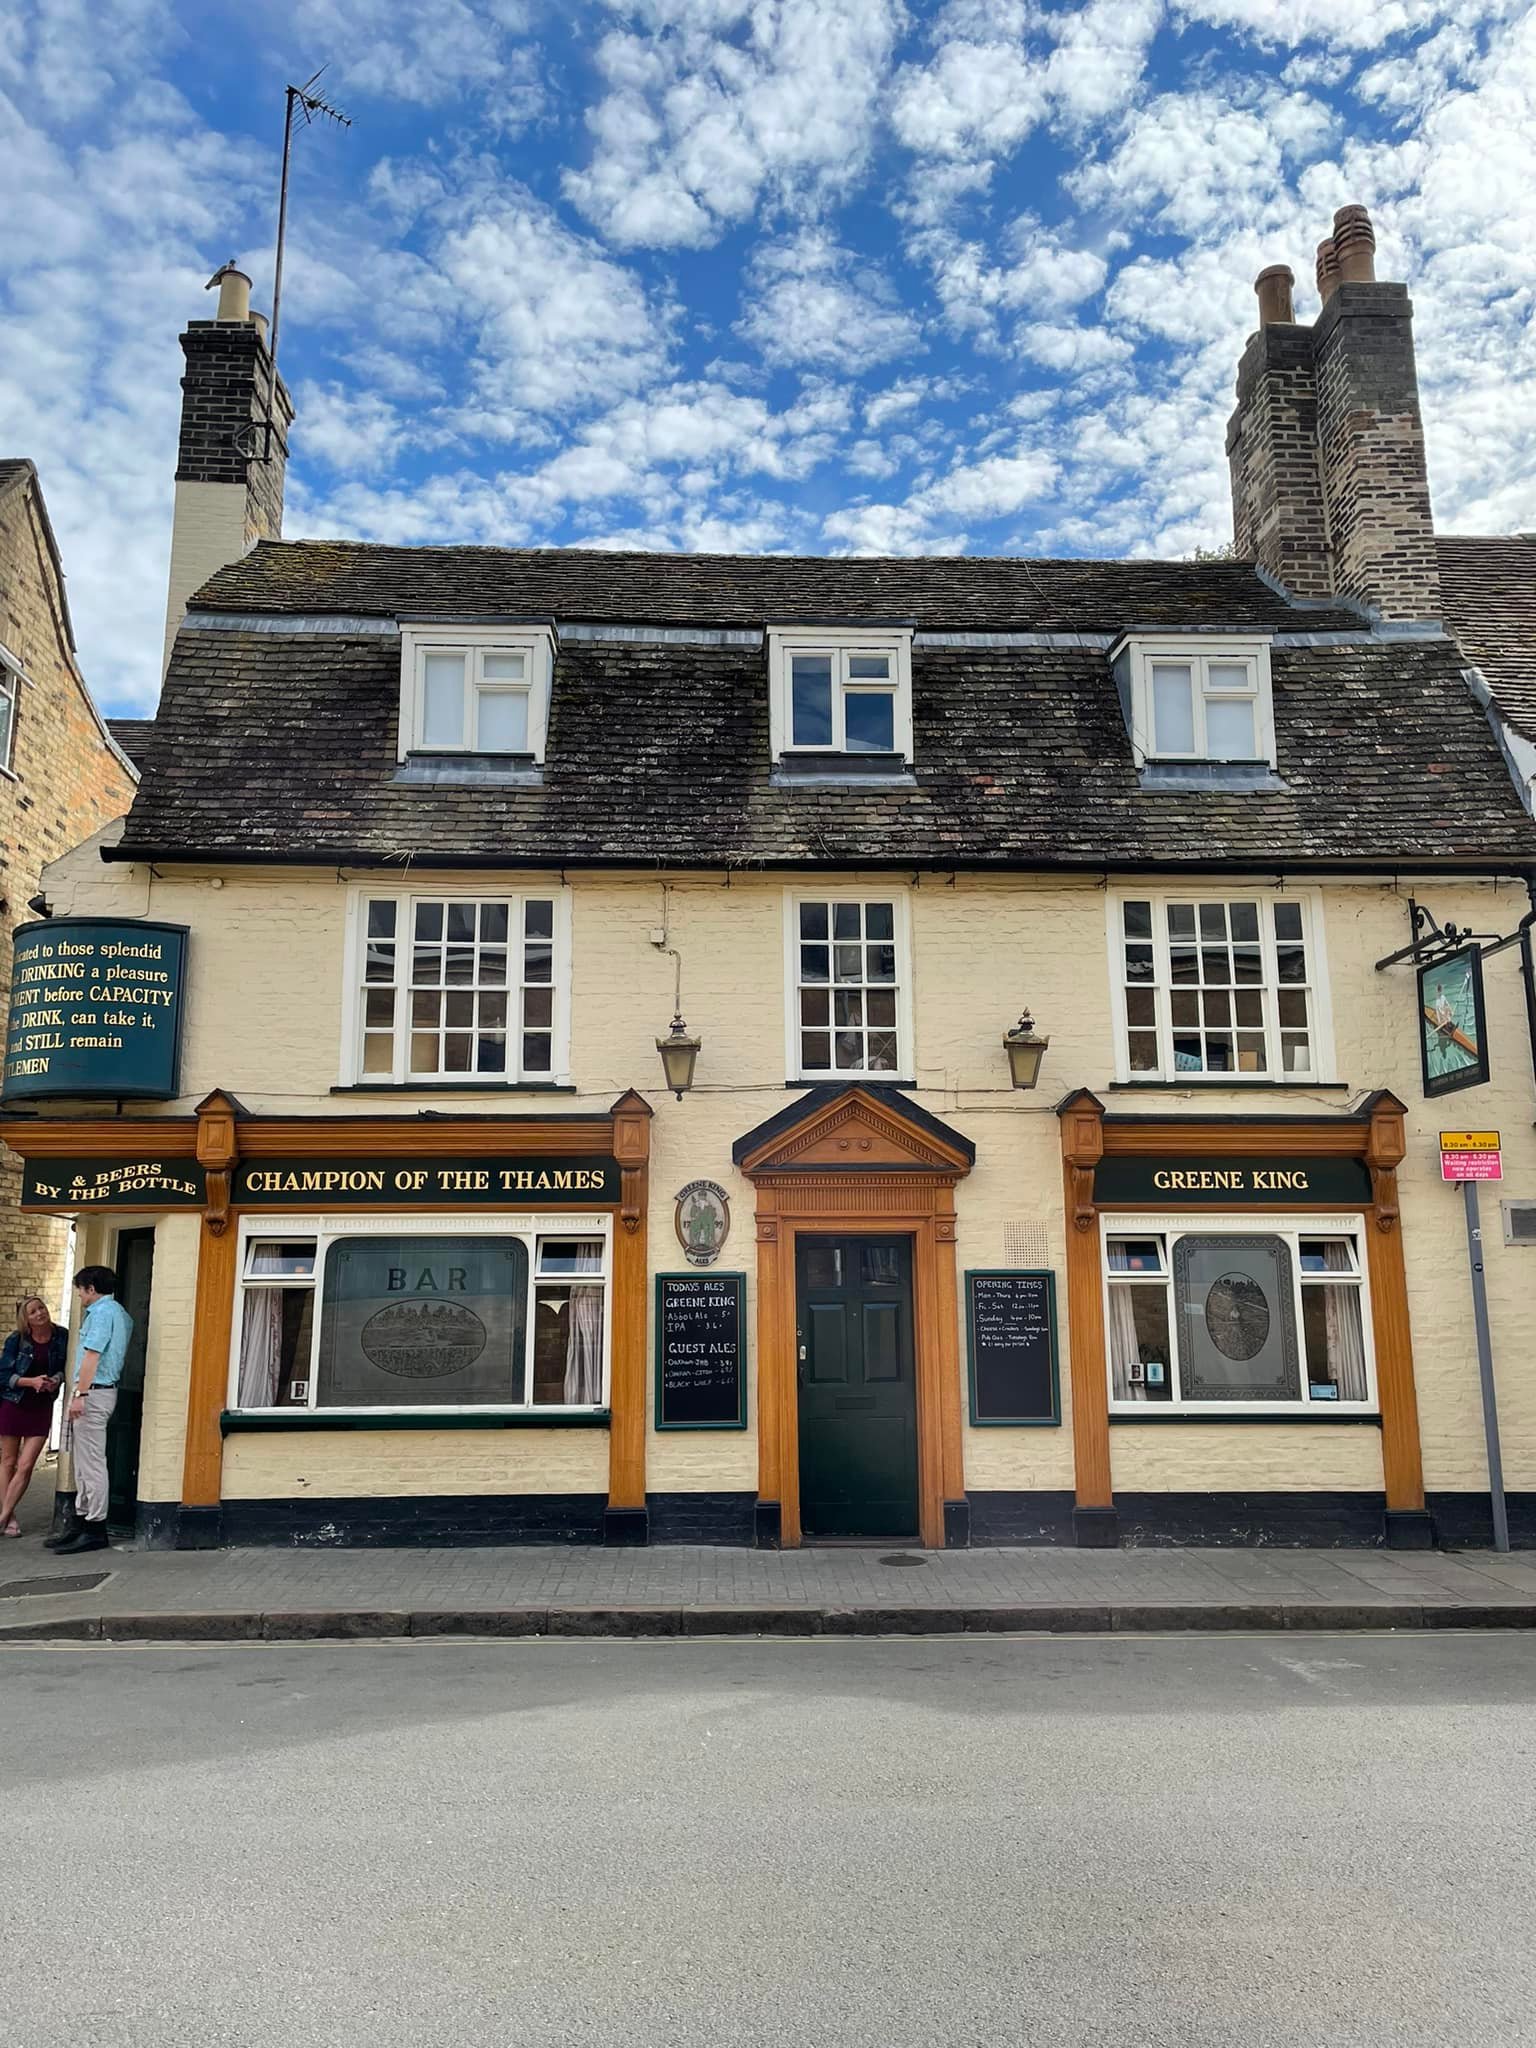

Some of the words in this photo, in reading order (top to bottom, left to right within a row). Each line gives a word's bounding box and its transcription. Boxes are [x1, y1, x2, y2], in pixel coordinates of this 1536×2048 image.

[42, 944, 53, 957] to
[58, 941, 94, 956] those
[100, 942, 162, 959] splendid
[21, 963, 85, 983] DRINKING
[91, 968, 99, 978] a
[106, 964, 168, 982] pleasure
[44, 987, 83, 1002] before
[90, 986, 173, 1006] CAPACITY
[22, 1010, 65, 1028] DRINK,
[71, 1013, 96, 1024] can
[104, 1010, 135, 1027] take
[142, 1012, 155, 1029] it,
[26, 1033, 64, 1051] STILL
[70, 1033, 122, 1048] remain
[72, 1176, 86, 1187] &
[95, 1163, 162, 1185] BEERS
[246, 1171, 385, 1191] CHAMPION
[395, 1171, 428, 1190] OF
[438, 1171, 489, 1189] THE
[500, 1170, 605, 1190] THAMES
[1154, 1171, 1244, 1189] GREENE
[1252, 1171, 1309, 1189] KING
[34, 1183, 61, 1198] BY
[69, 1186, 110, 1200] THE
[118, 1177, 196, 1196] BOTTLE
[680, 1181, 707, 1198] GREENE
[708, 1182, 727, 1198] KING
[387, 1268, 466, 1291] BAR
[704, 1282, 725, 1291] ALES
[1016, 1281, 1042, 1289] TIMES
[666, 1297, 706, 1308] GREENE
[709, 1297, 735, 1307] KING
[667, 1322, 686, 1332] IPA
[979, 1314, 1003, 1324] Sunday
[668, 1342, 705, 1353] GUEST
[709, 1343, 736, 1353] ALES
